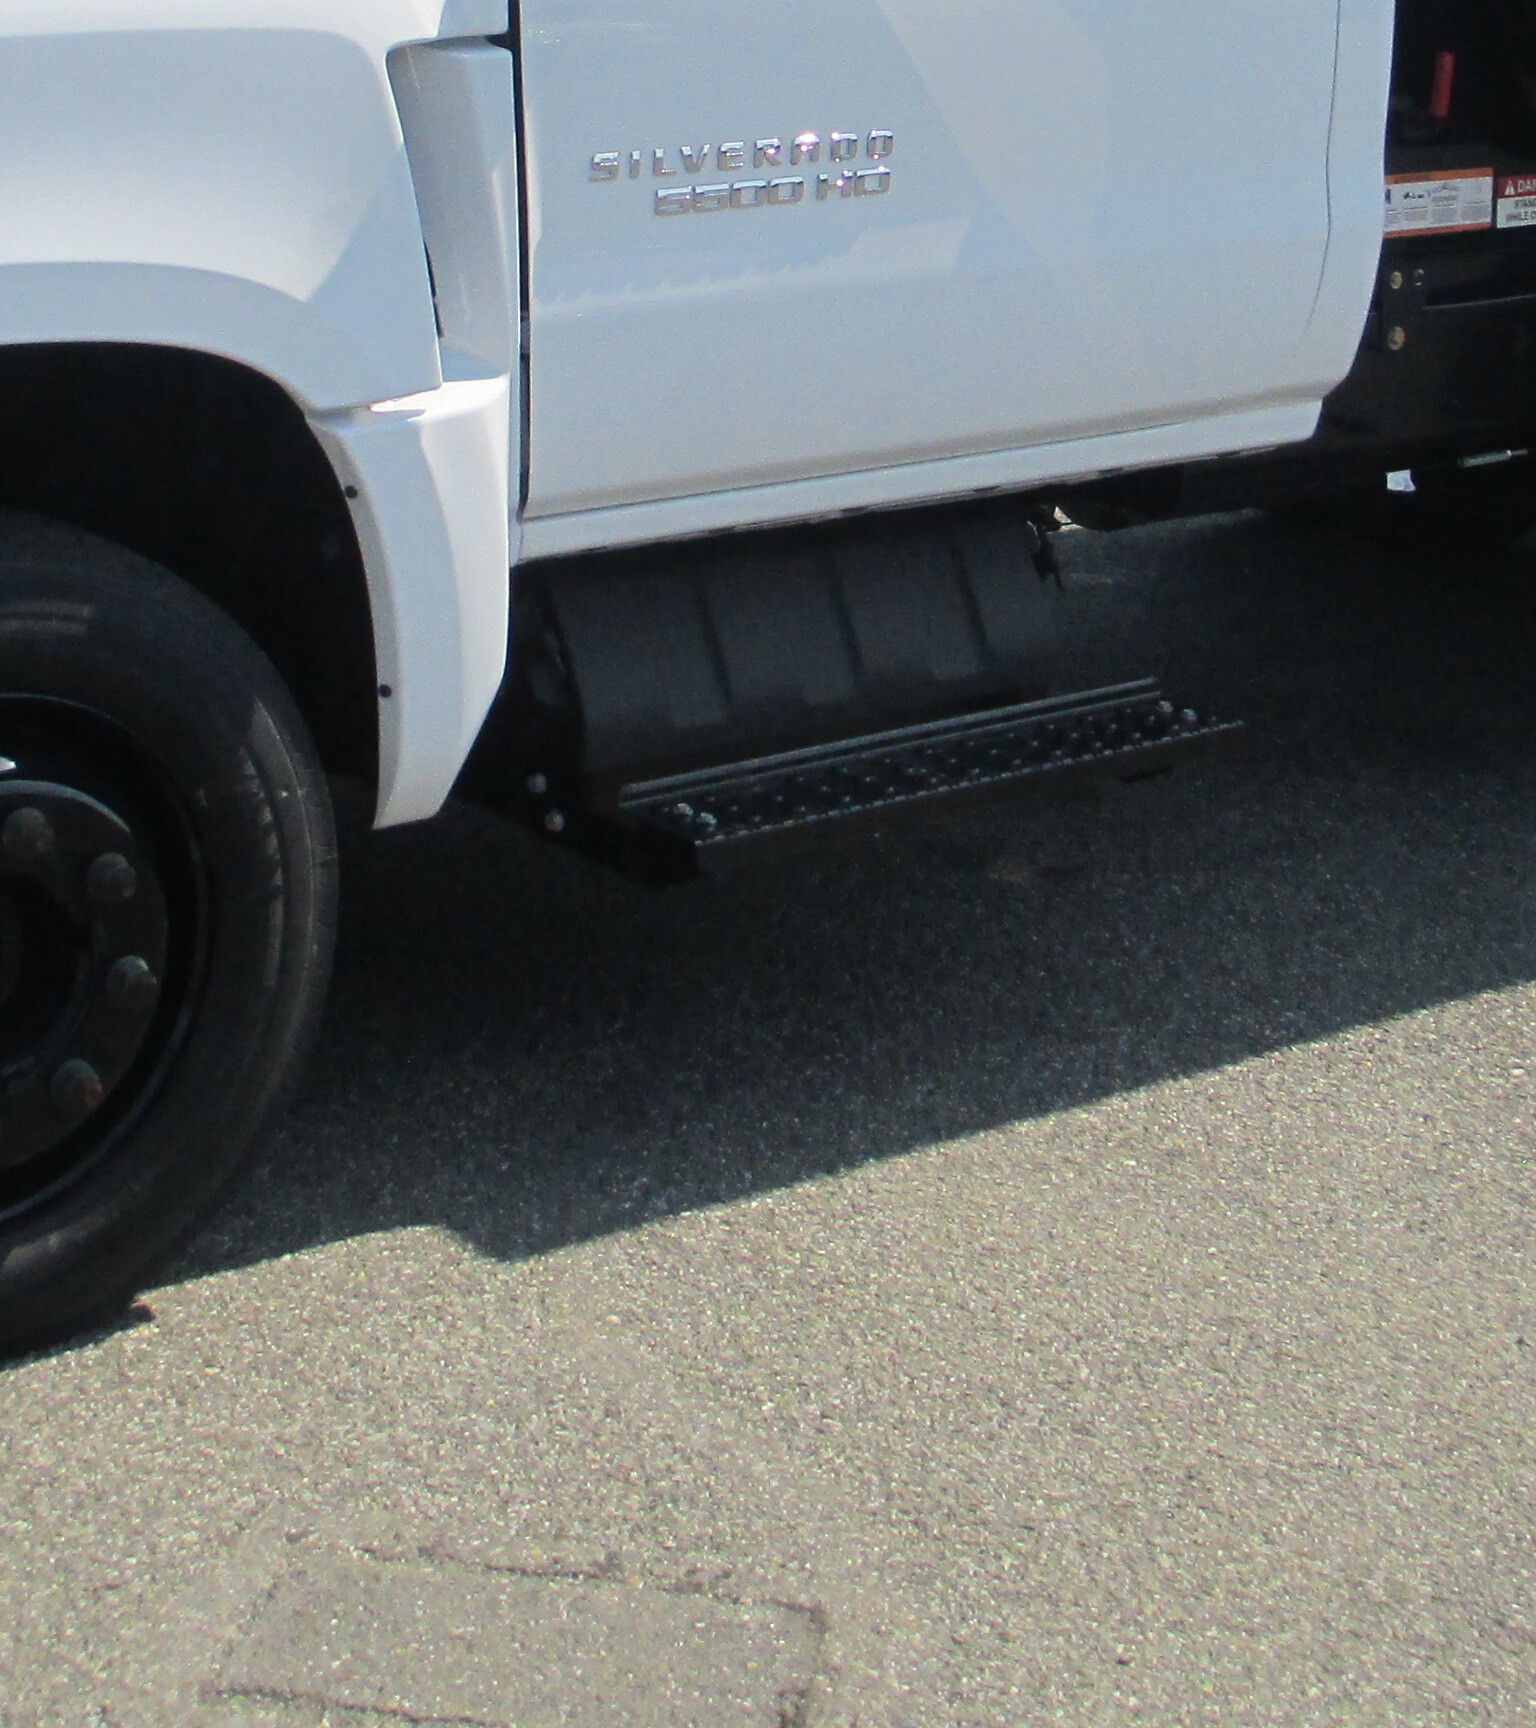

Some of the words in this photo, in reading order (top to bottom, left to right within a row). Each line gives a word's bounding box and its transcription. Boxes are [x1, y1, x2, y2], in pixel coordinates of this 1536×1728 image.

[590, 129, 893, 183] SILVERADO
[654, 175, 805, 217] 5500
[817, 165, 892, 201] HD
